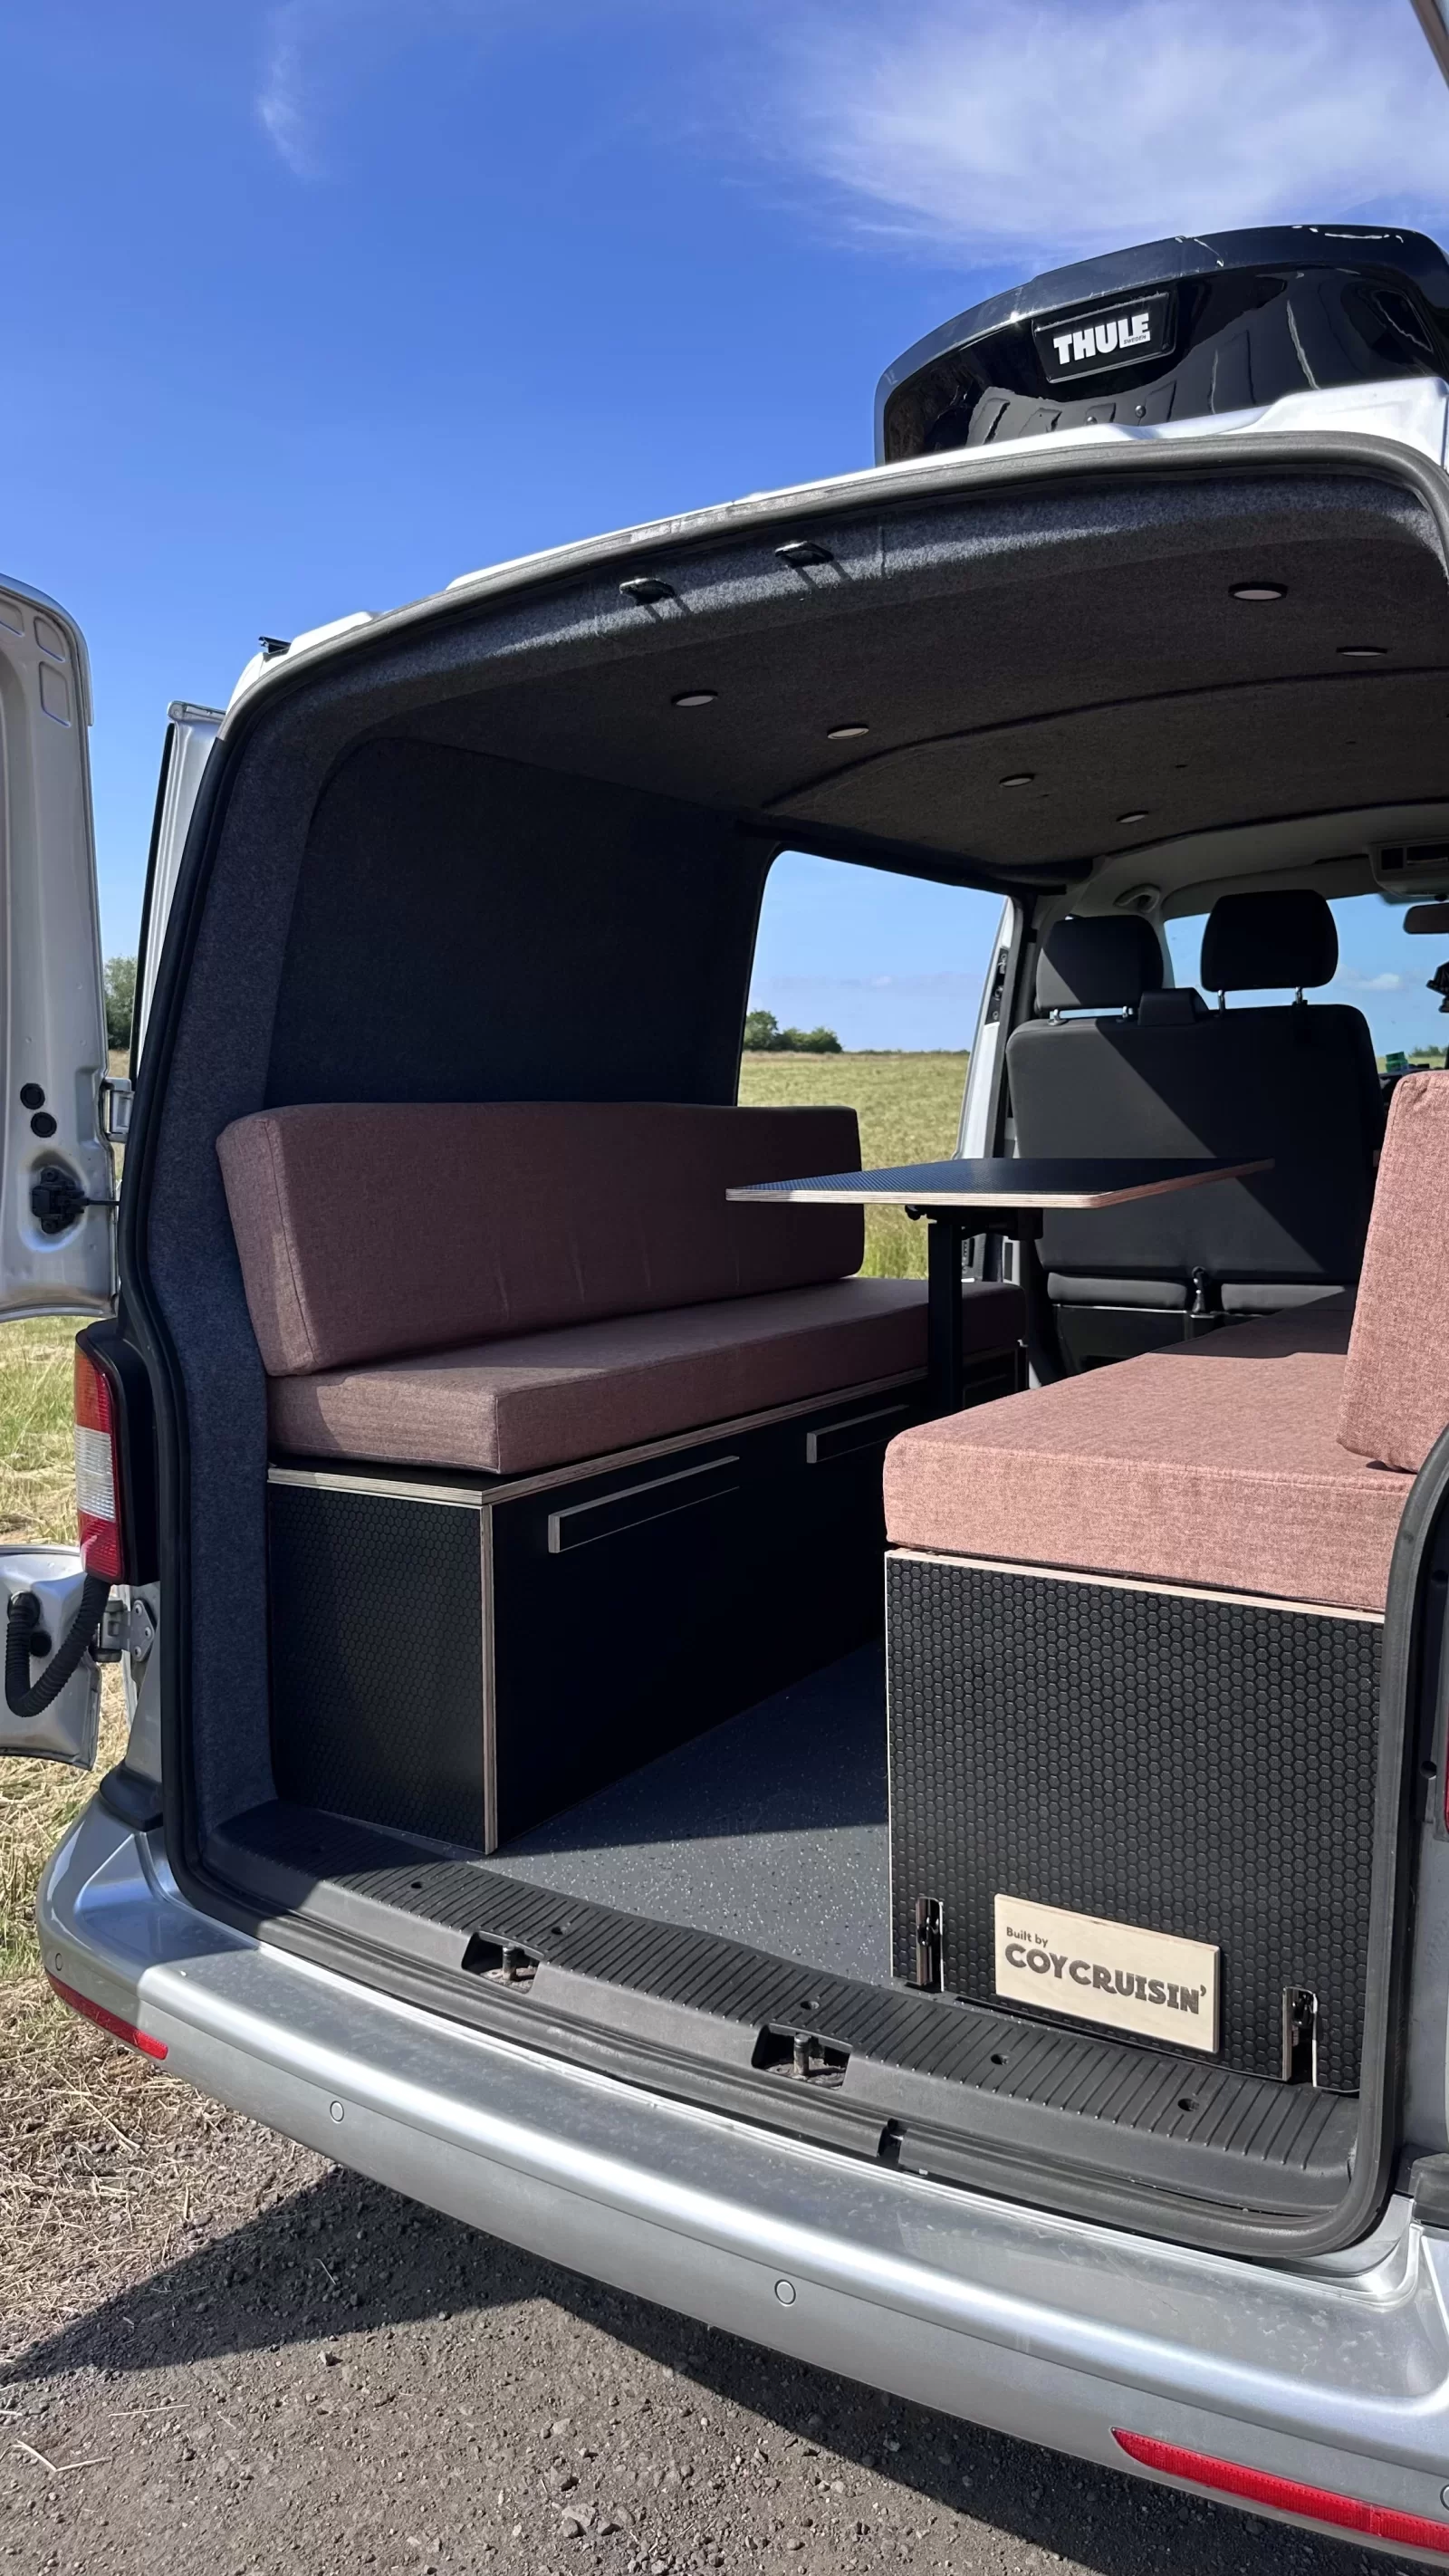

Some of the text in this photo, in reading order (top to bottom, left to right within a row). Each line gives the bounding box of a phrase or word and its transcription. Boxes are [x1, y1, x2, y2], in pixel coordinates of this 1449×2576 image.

[1053, 312, 1151, 365] THULE
[1006, 1926, 1049, 1948] Built by
